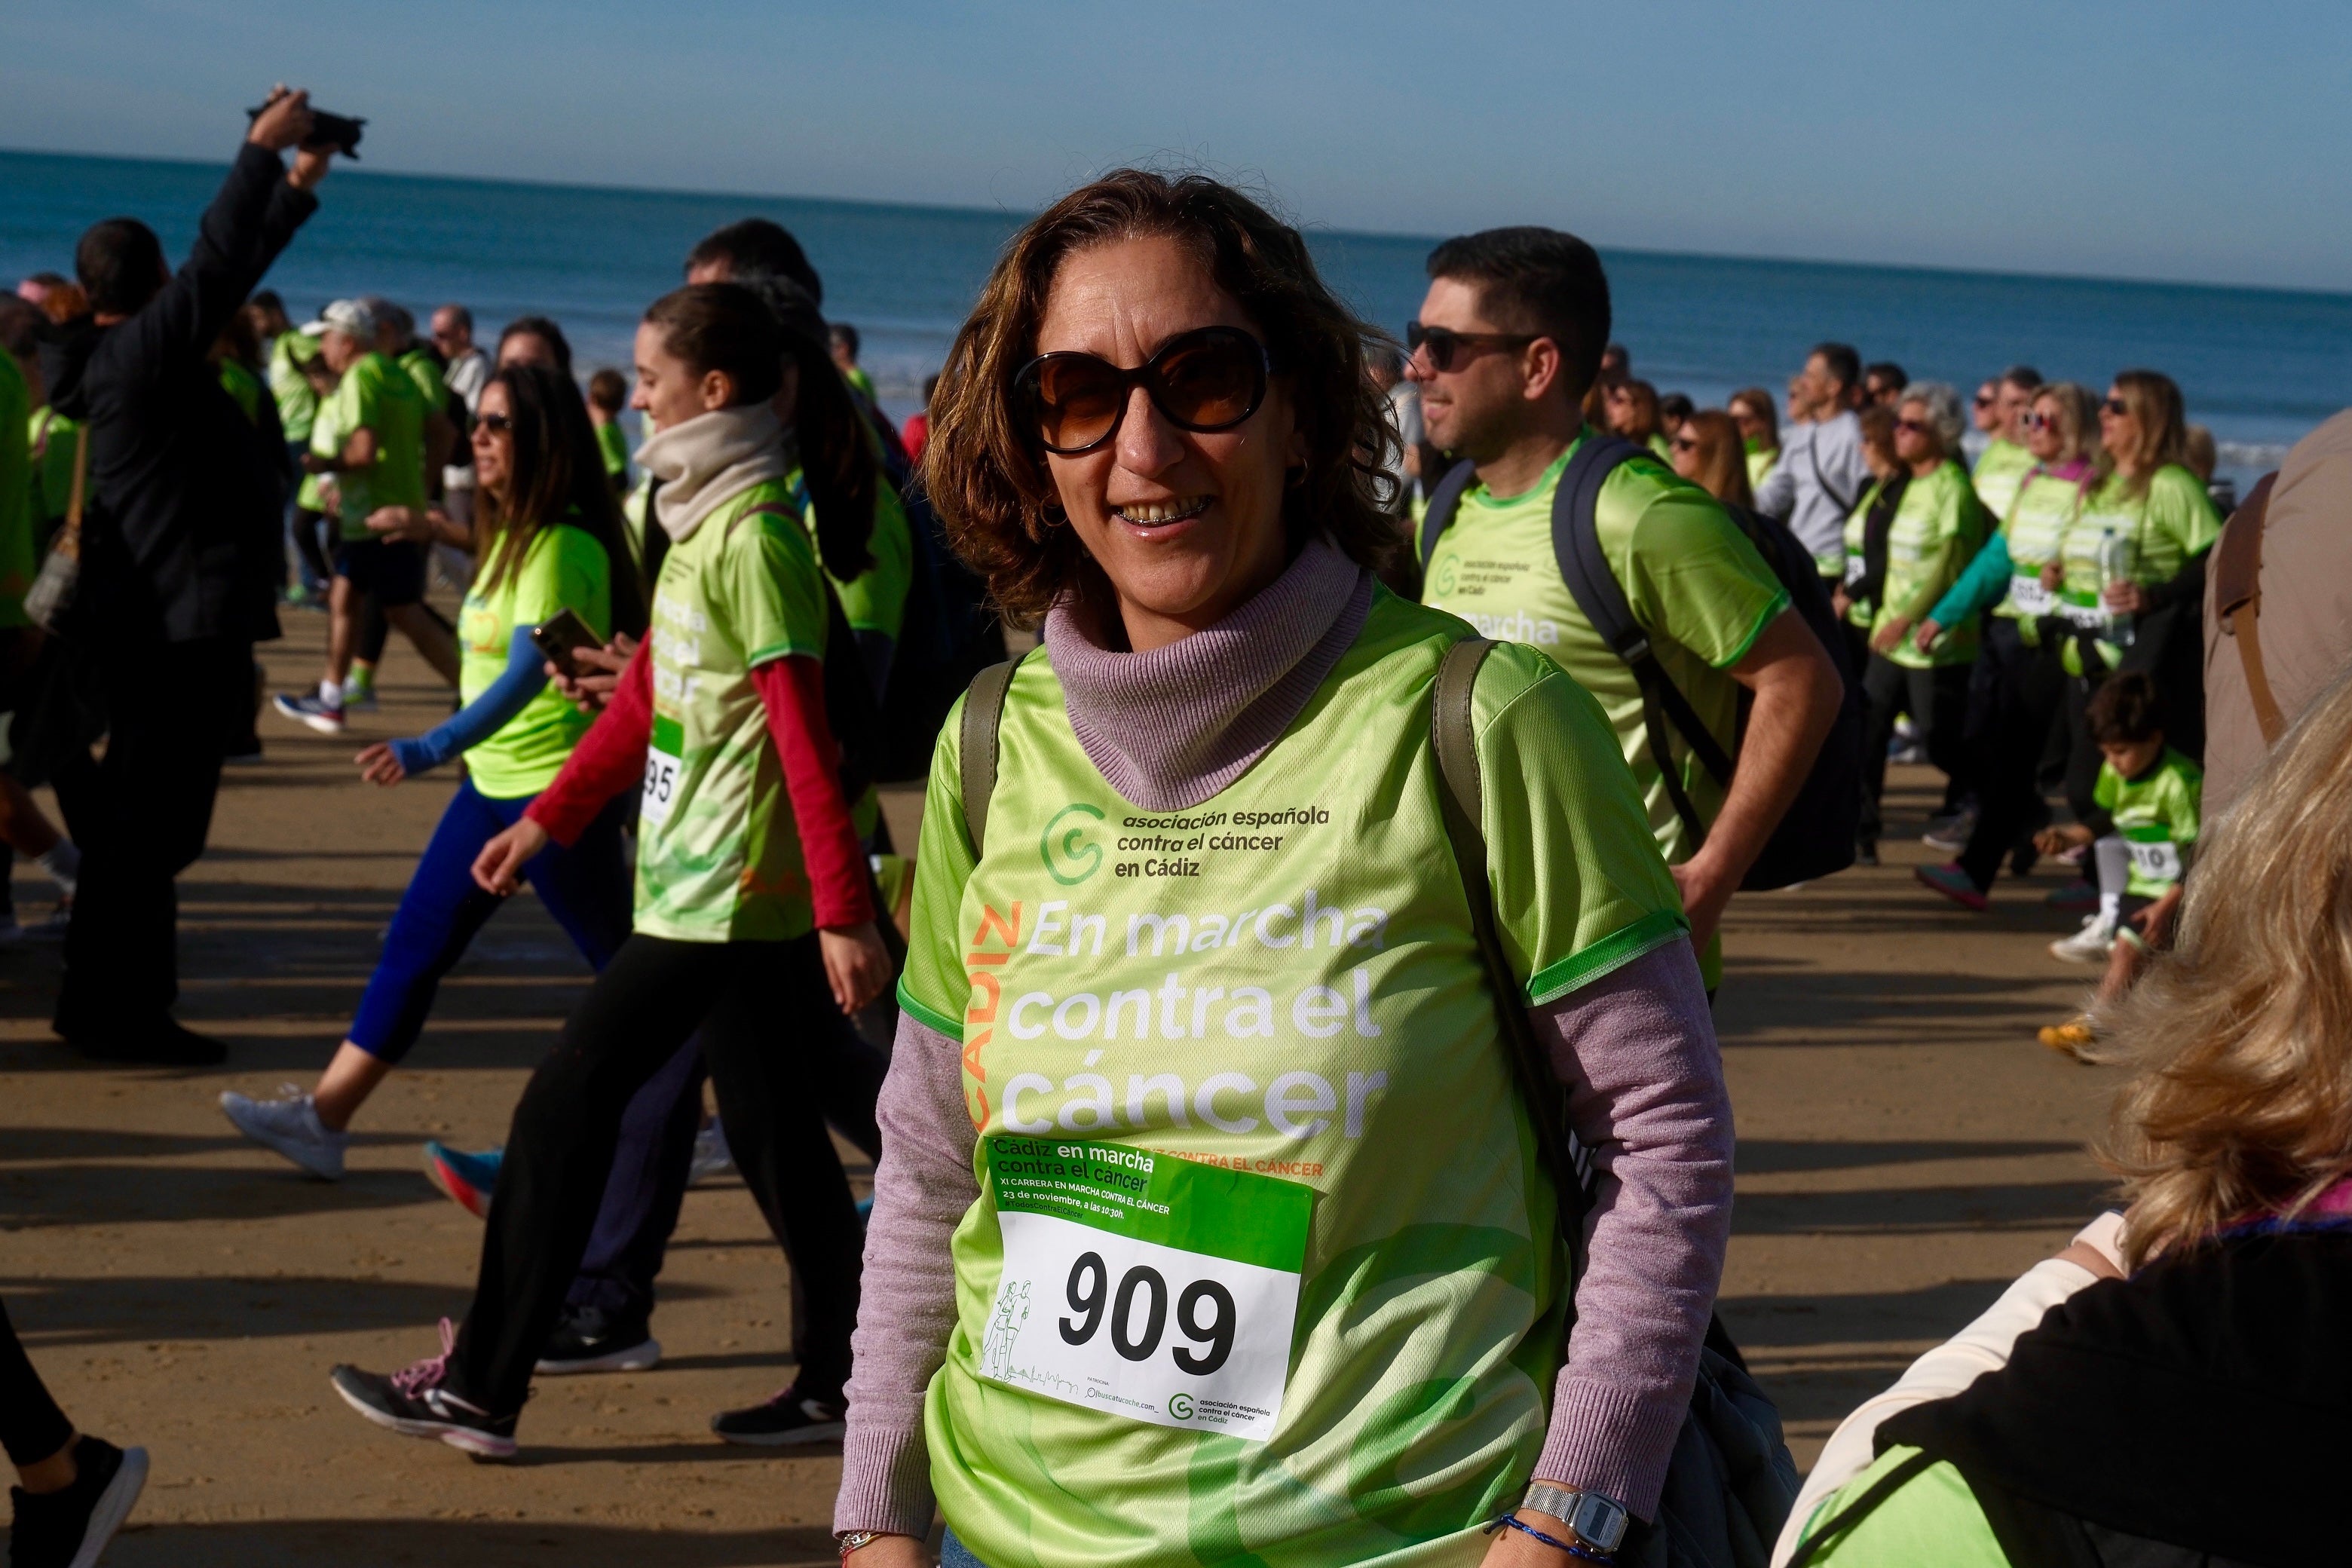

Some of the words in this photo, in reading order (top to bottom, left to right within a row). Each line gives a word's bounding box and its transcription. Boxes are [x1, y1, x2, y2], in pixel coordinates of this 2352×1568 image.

[1123, 811, 1227, 829] asociación
[1233, 806, 1330, 828] española
[1117, 835, 1184, 852] contra
[1187, 833, 1205, 850] el
[1209, 831, 1283, 850] cáncer
[1115, 862, 1139, 877] en
[1145, 857, 1200, 877] Cádiz
[1026, 900, 1107, 957] En
[1125, 890, 1388, 957] marcha
[1006, 972, 1275, 1041] contra
[1292, 969, 1383, 1040] el
[1001, 1049, 1389, 1140] cáncer
[994, 1139, 1052, 1157] Cádiz
[1057, 1145, 1083, 1159] en
[1089, 1147, 1154, 1173] marcha
[1233, 1157, 1252, 1171] EL
[1255, 1158, 1324, 1177] CÁNCER
[998, 1159, 1066, 1175] contra
[1071, 1162, 1090, 1179] el
[1094, 1165, 1148, 1192] cáncer
[1011, 1178, 1053, 1188] CARRERA
[1055, 1181, 1067, 1190] EN
[1069, 1183, 1100, 1197] MARCHA
[1101, 1190, 1125, 1205] CONTRA
[1127, 1197, 1135, 1206] EL
[1136, 1199, 1170, 1215] CÁNCER
[1033, 1193, 1083, 1208] noviembre,
[1090, 1201, 1101, 1212] las
[1058, 1251, 1236, 1377] 909
[1199, 1407, 1221, 1416] contra
[1231, 1411, 1255, 1422] cáncer
[1200, 1400, 1237, 1410] asociación
[1239, 1405, 1270, 1416] española
[1208, 1416, 1228, 1424] Cádiz
